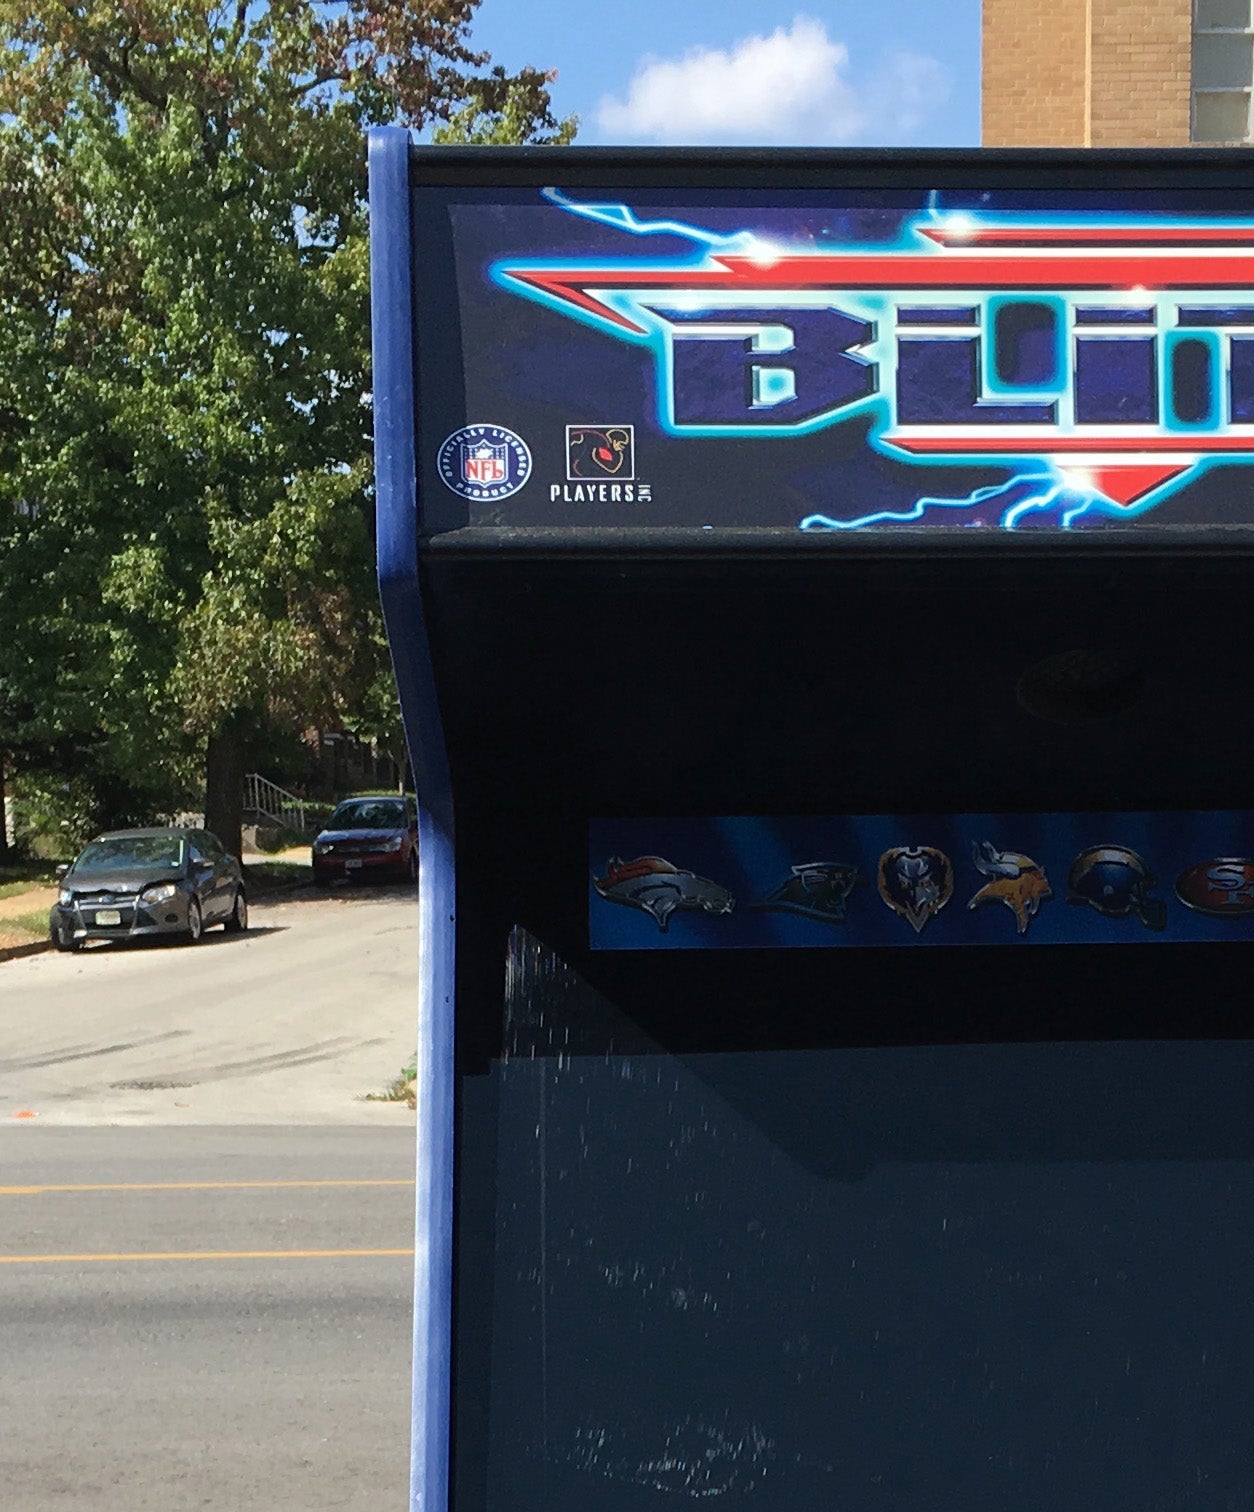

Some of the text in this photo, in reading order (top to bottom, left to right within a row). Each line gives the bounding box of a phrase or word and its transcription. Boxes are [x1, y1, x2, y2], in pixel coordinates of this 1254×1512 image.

[441, 428, 527, 477] OFFICIALLY LICENSED
[465, 458, 504, 481] NFL
[455, 482, 514, 498] PRODUCT
[550, 484, 652, 502] PLAYERS INC
